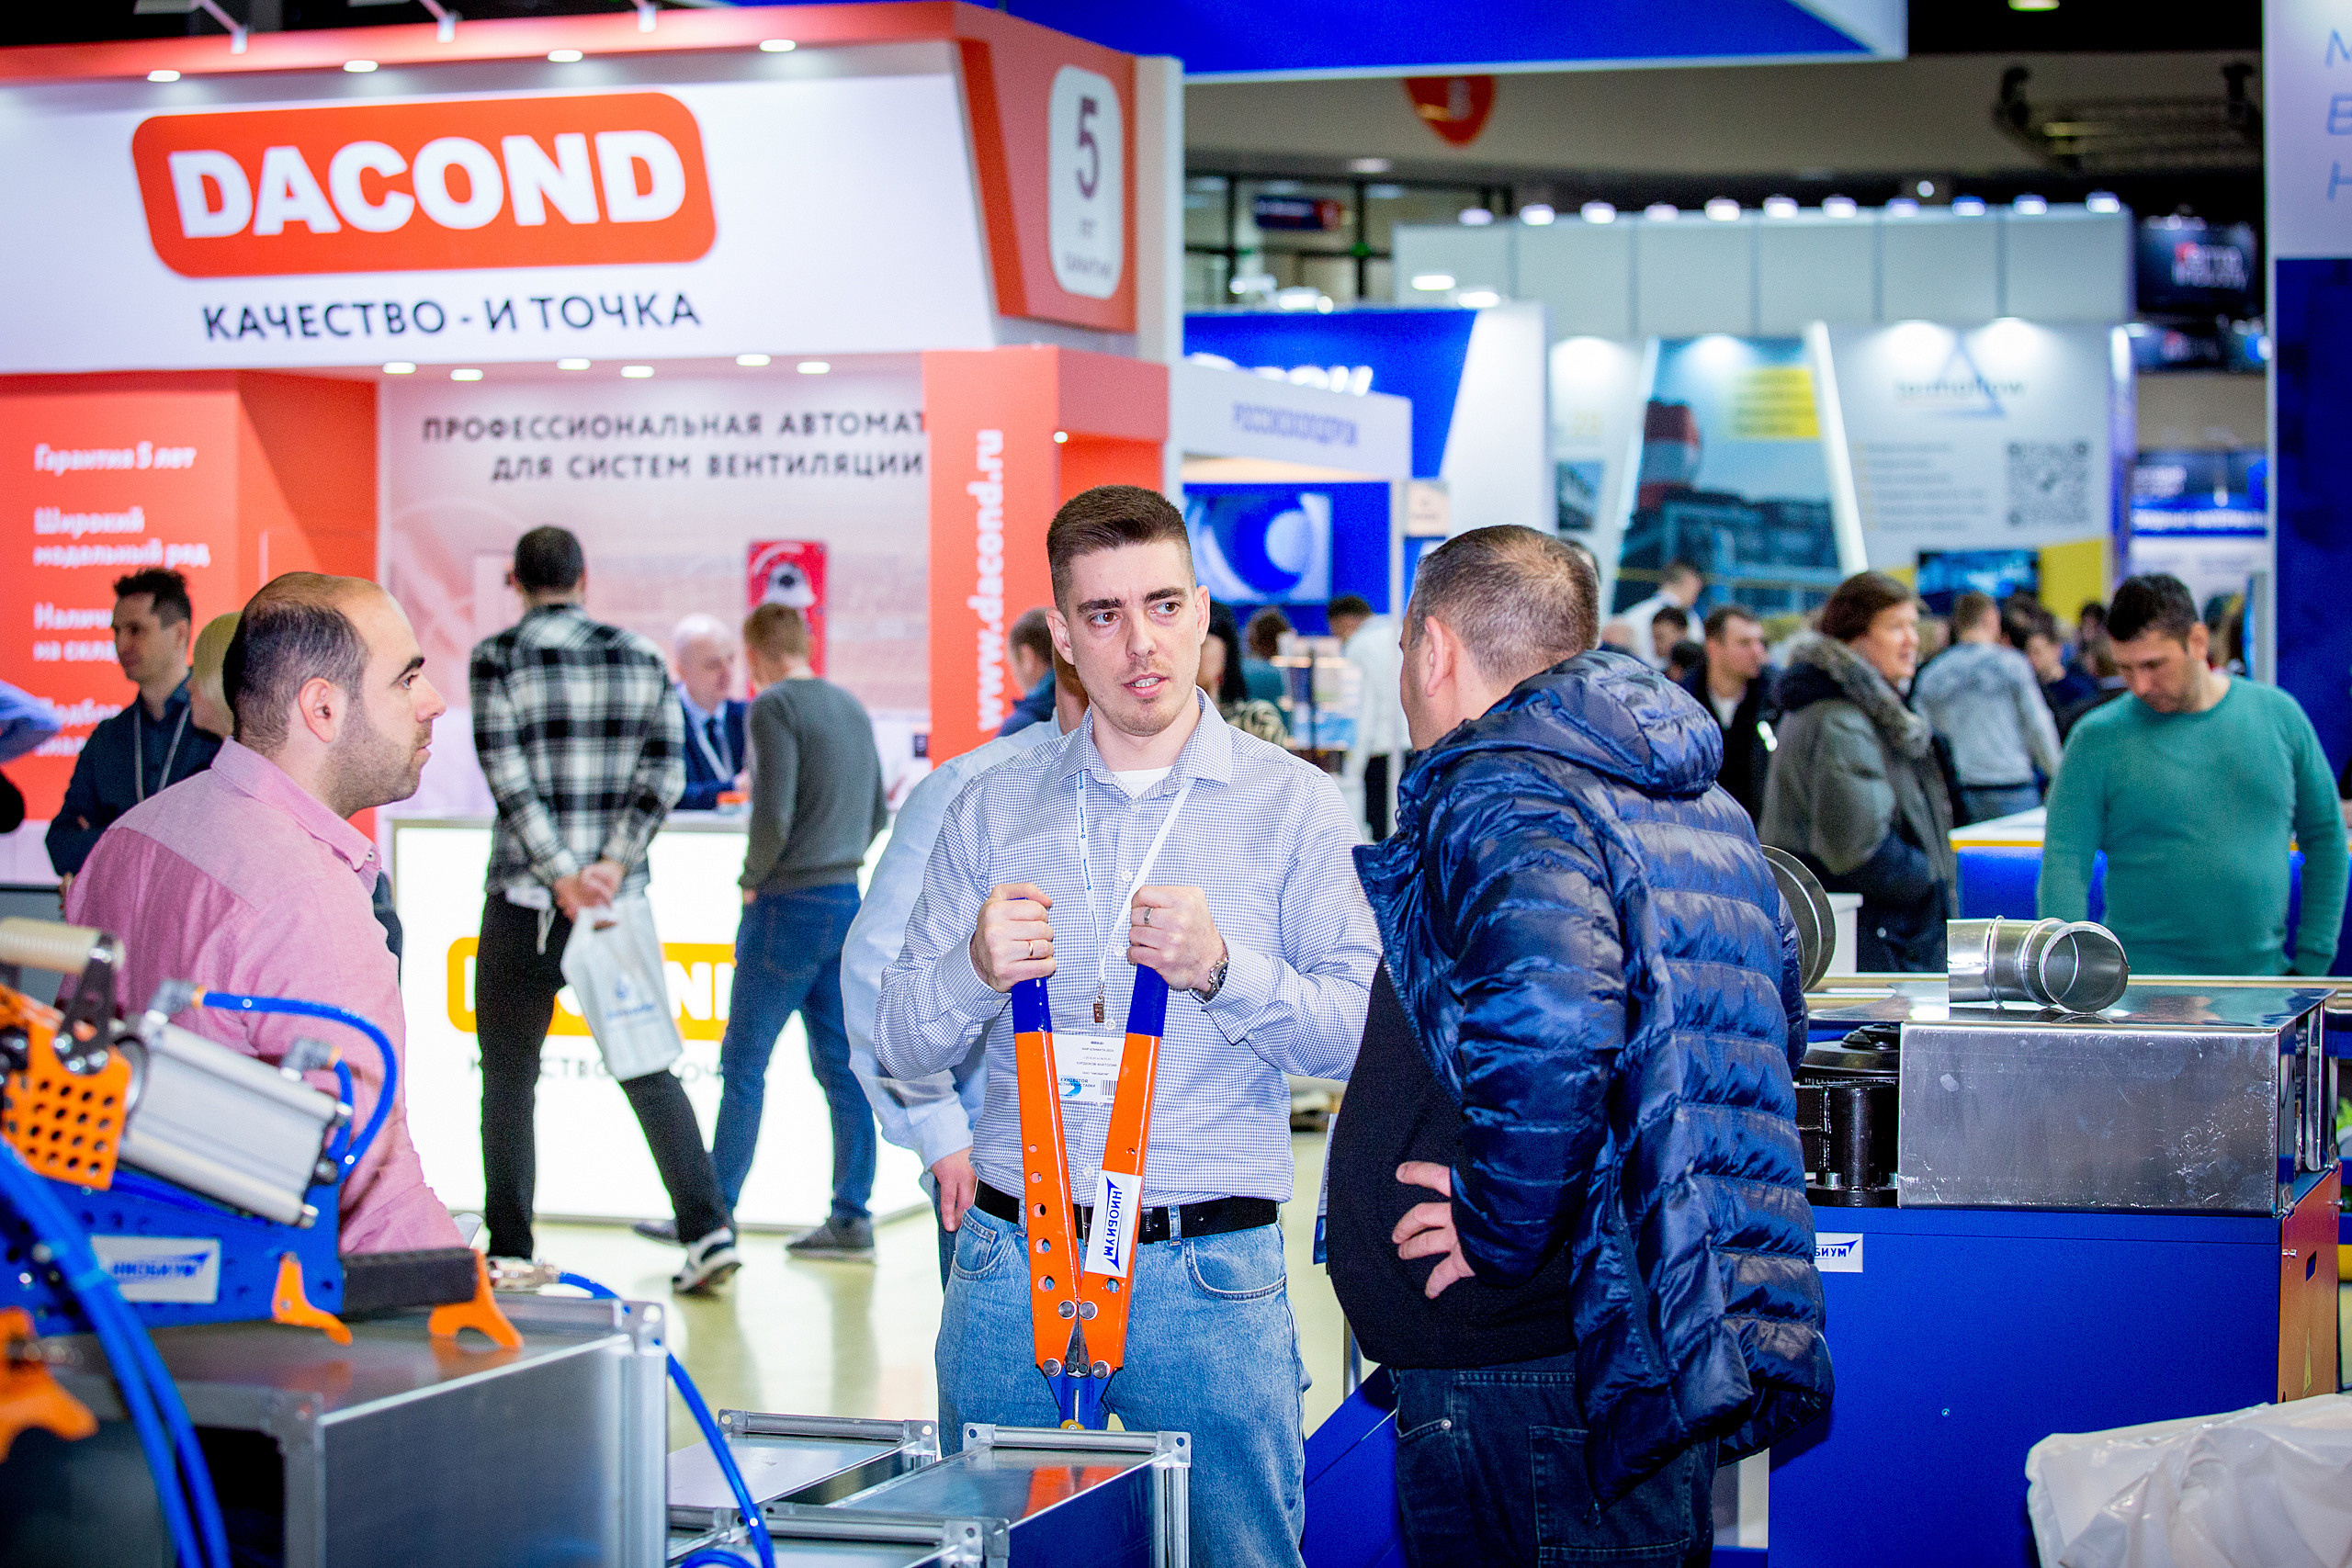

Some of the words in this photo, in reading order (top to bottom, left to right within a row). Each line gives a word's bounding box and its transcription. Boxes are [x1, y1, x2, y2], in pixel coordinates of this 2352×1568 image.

[1076, 96, 1100, 200] 5
[168, 130, 687, 240] DACOND
[203, 299, 447, 342] КАЧЕСТВО
[485, 299, 517, 332] И
[529, 292, 702, 331] ТОЧКА
[423, 411, 763, 442] ПРОФЕССИОНАЛЬНАЯ
[779, 409, 926, 436] АВТОМАТ
[491, 457, 553, 484] ДЛЯ
[567, 453, 691, 479] СИСТЕМ
[707, 451, 924, 479] ВЕНТИЛЯЦИИ
[967, 429, 1004, 733] www.dacond.ru
[1103, 1190, 1123, 1258] НИОБИУМ
[1815, 1247, 1847, 1257] БИУМ
